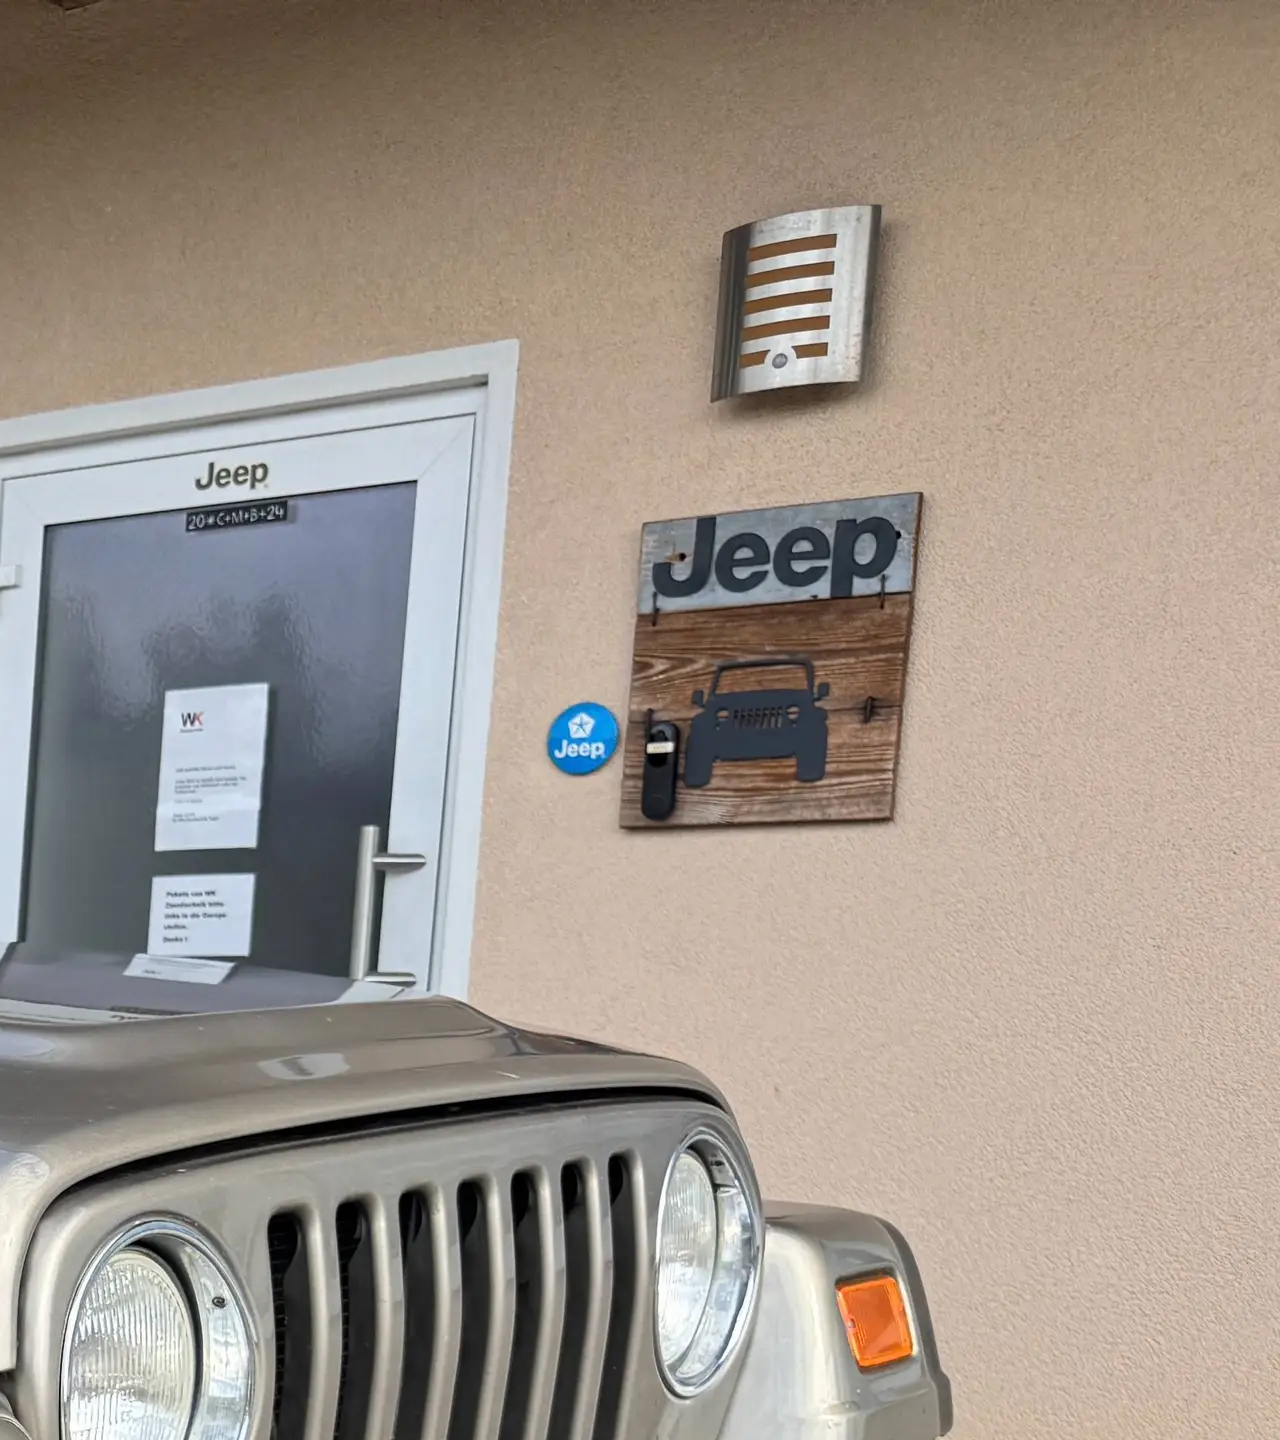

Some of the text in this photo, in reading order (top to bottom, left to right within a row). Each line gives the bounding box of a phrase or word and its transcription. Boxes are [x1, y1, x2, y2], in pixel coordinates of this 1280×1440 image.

[195, 462, 268, 491] Jeep
[652, 516, 898, 599] Jeep
[554, 739, 606, 760] Jeep
